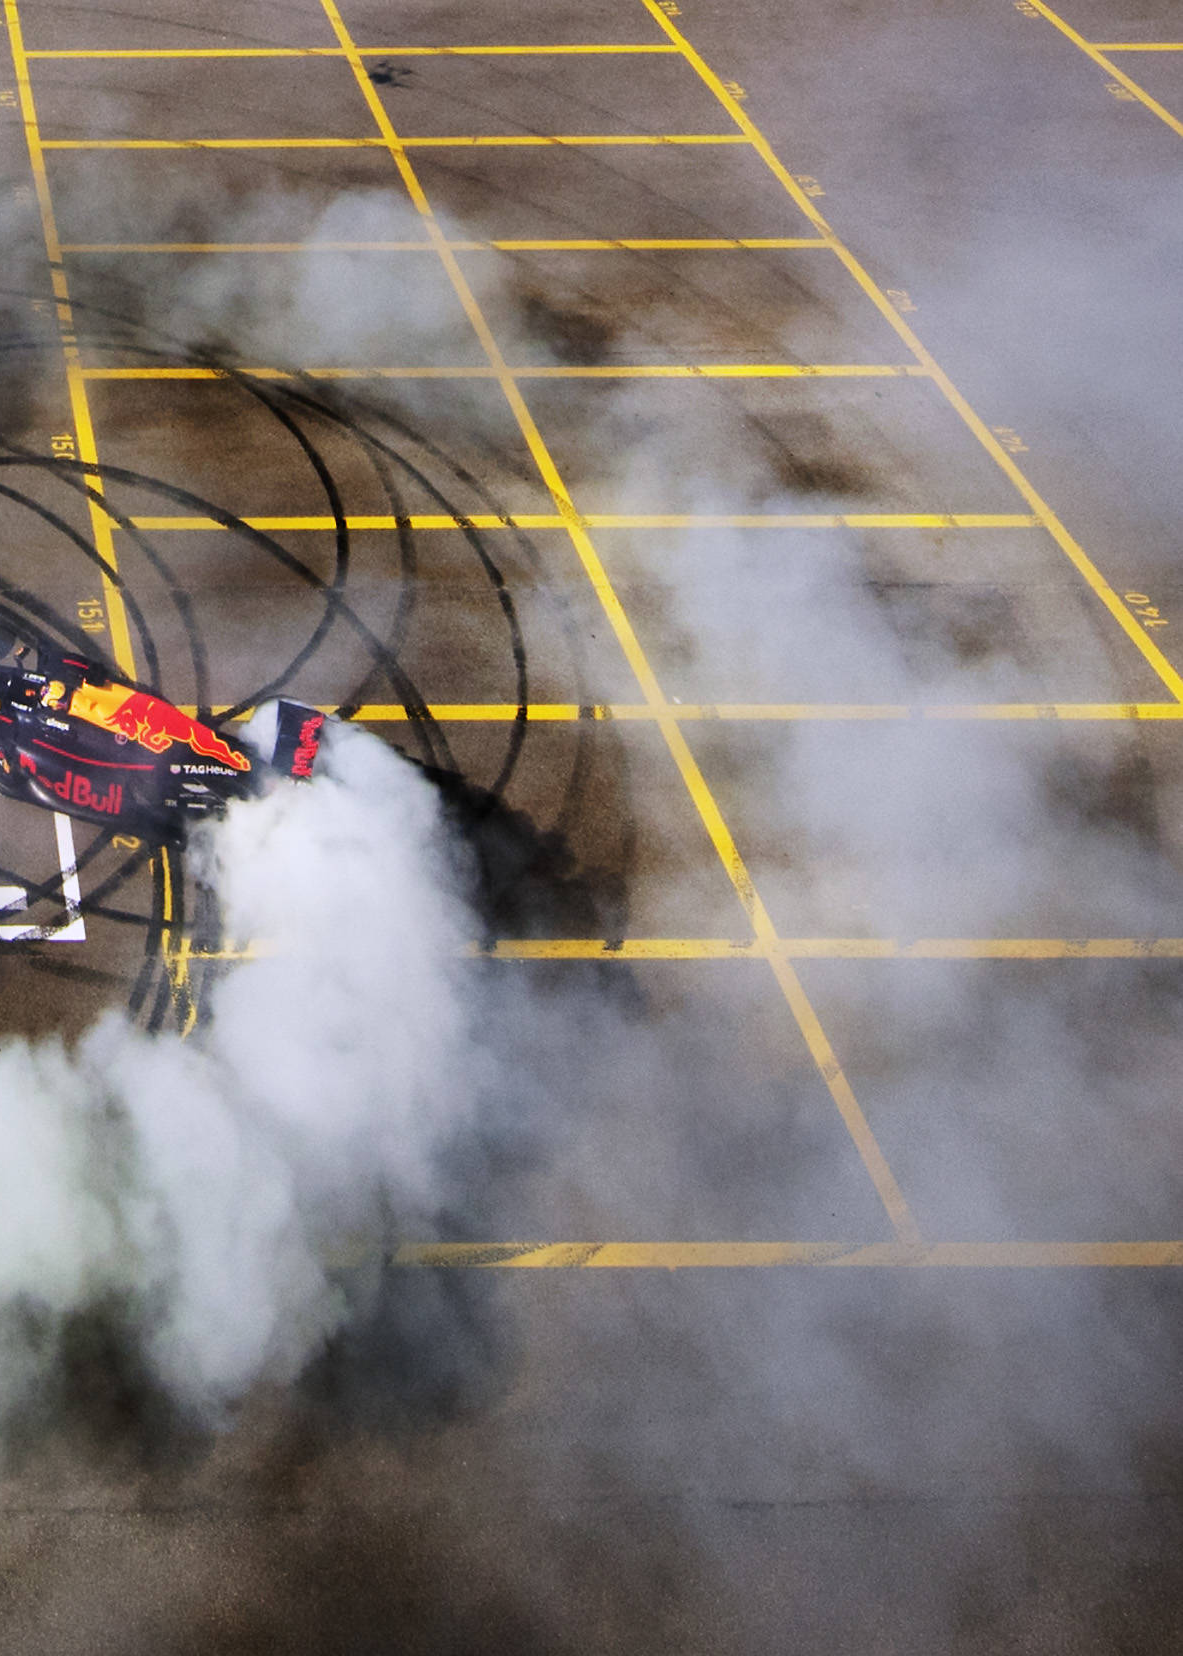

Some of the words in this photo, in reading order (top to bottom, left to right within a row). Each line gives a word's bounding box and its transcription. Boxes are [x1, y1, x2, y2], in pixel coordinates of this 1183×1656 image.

[77, 599, 105, 634] 151
[1124, 592, 1169, 627] 140
[73, 775, 123, 815] Bull
